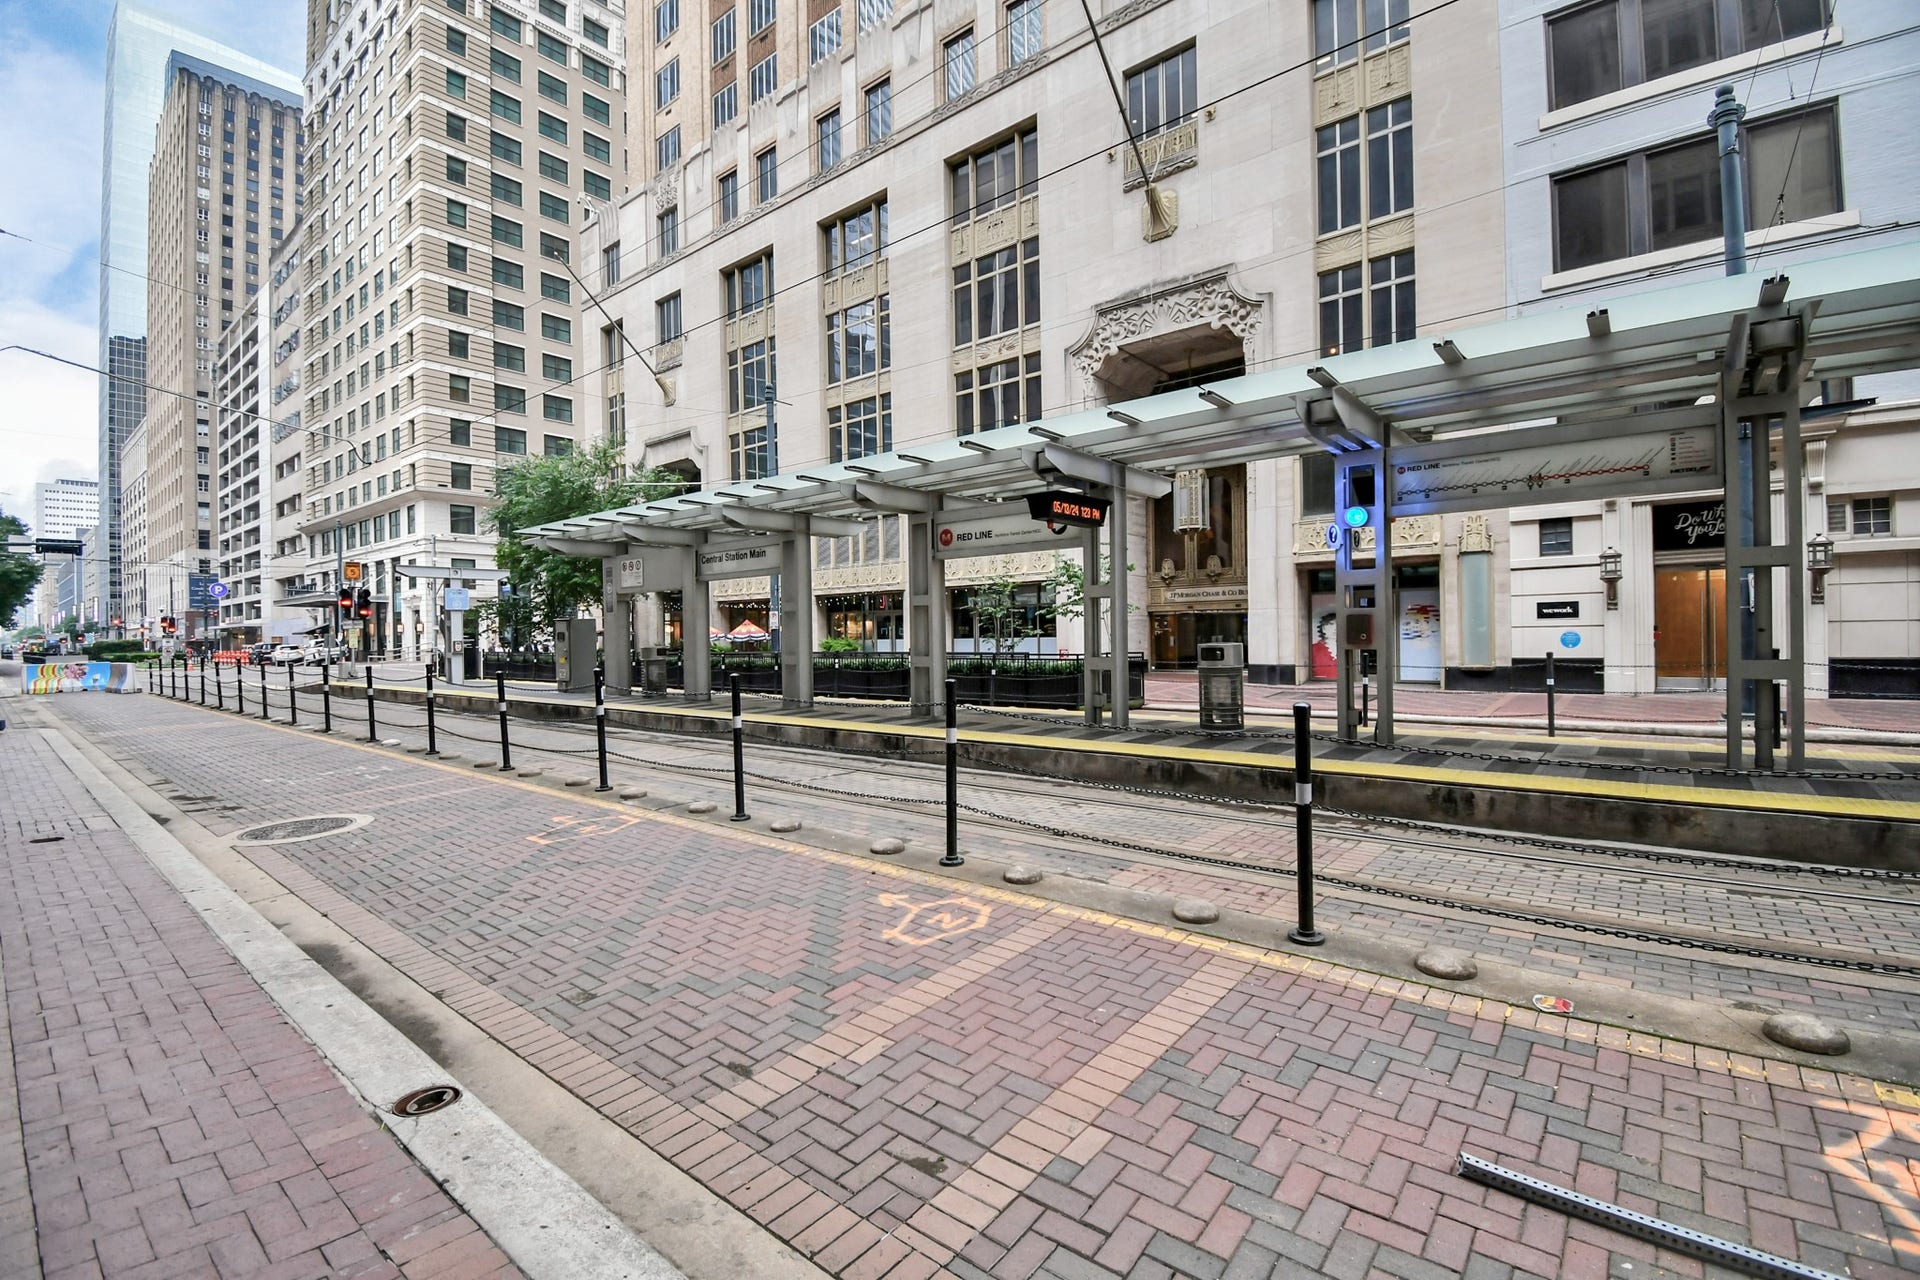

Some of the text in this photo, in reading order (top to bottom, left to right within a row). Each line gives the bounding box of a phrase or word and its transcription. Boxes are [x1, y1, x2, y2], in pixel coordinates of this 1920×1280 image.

[956, 532, 973, 542] RED
[974, 530, 993, 540] LINE
[701, 548, 767, 564] Central Station Main
[1542, 606, 1574, 614] wework
